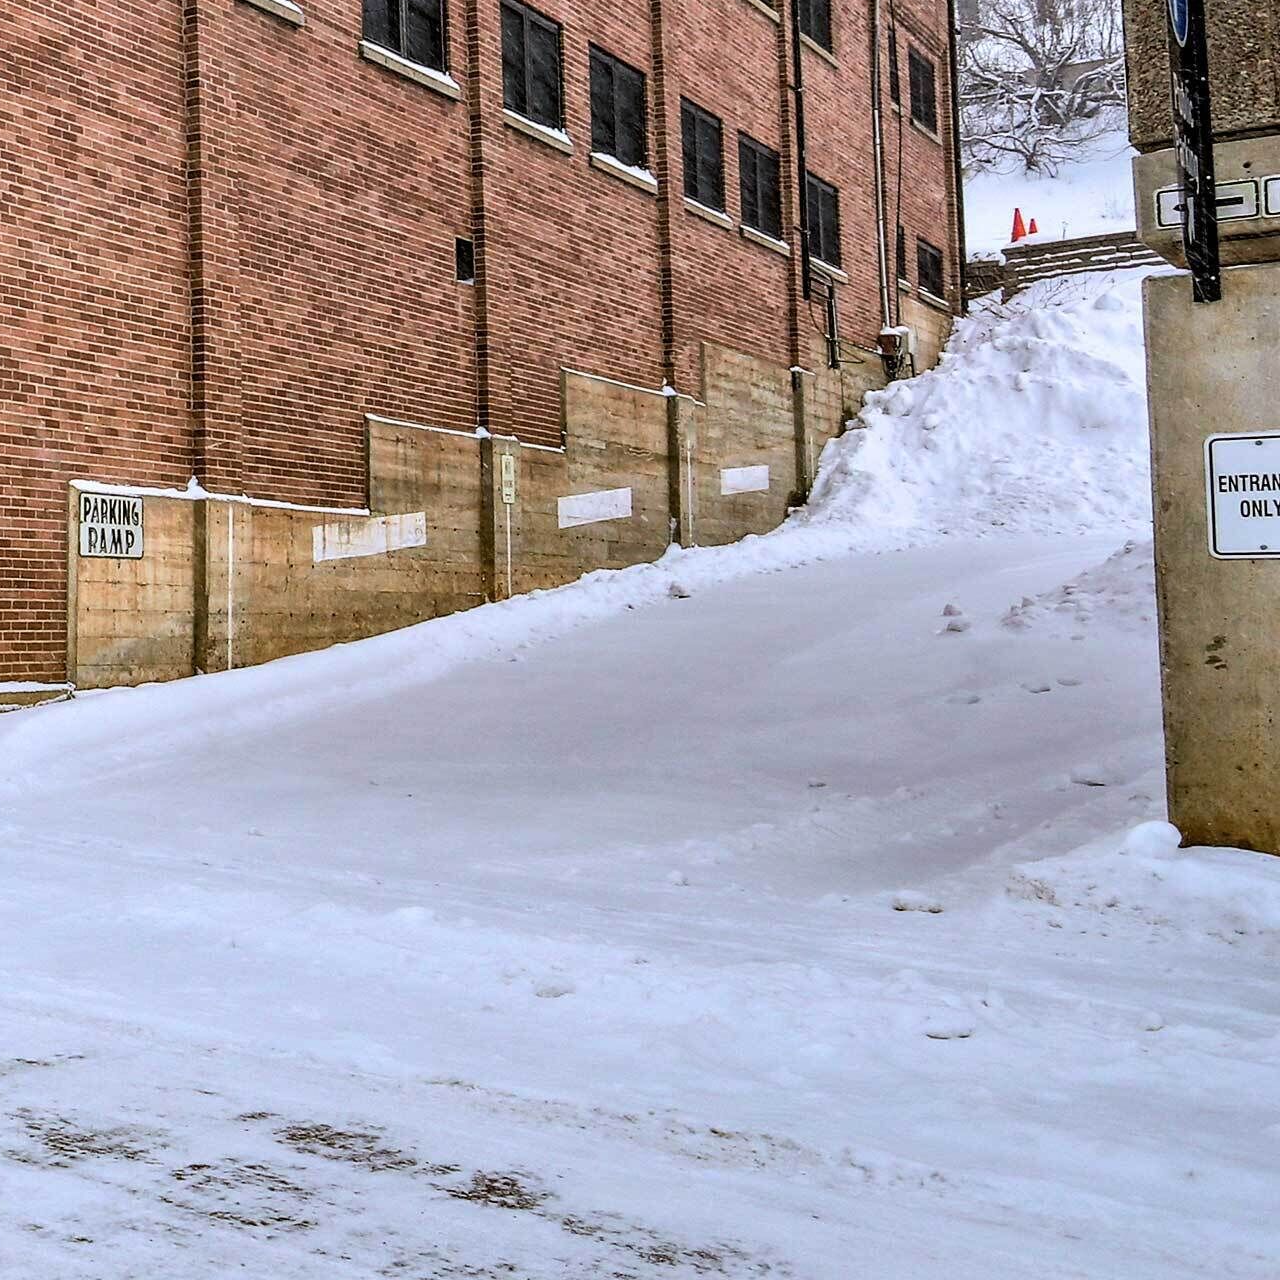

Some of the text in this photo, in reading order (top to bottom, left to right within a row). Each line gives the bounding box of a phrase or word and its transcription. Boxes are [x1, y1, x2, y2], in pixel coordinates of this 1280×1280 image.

[1218, 473, 1280, 493] ENTRAN
[83, 497, 139, 526] PARKING
[88, 527, 135, 554] RAMP
